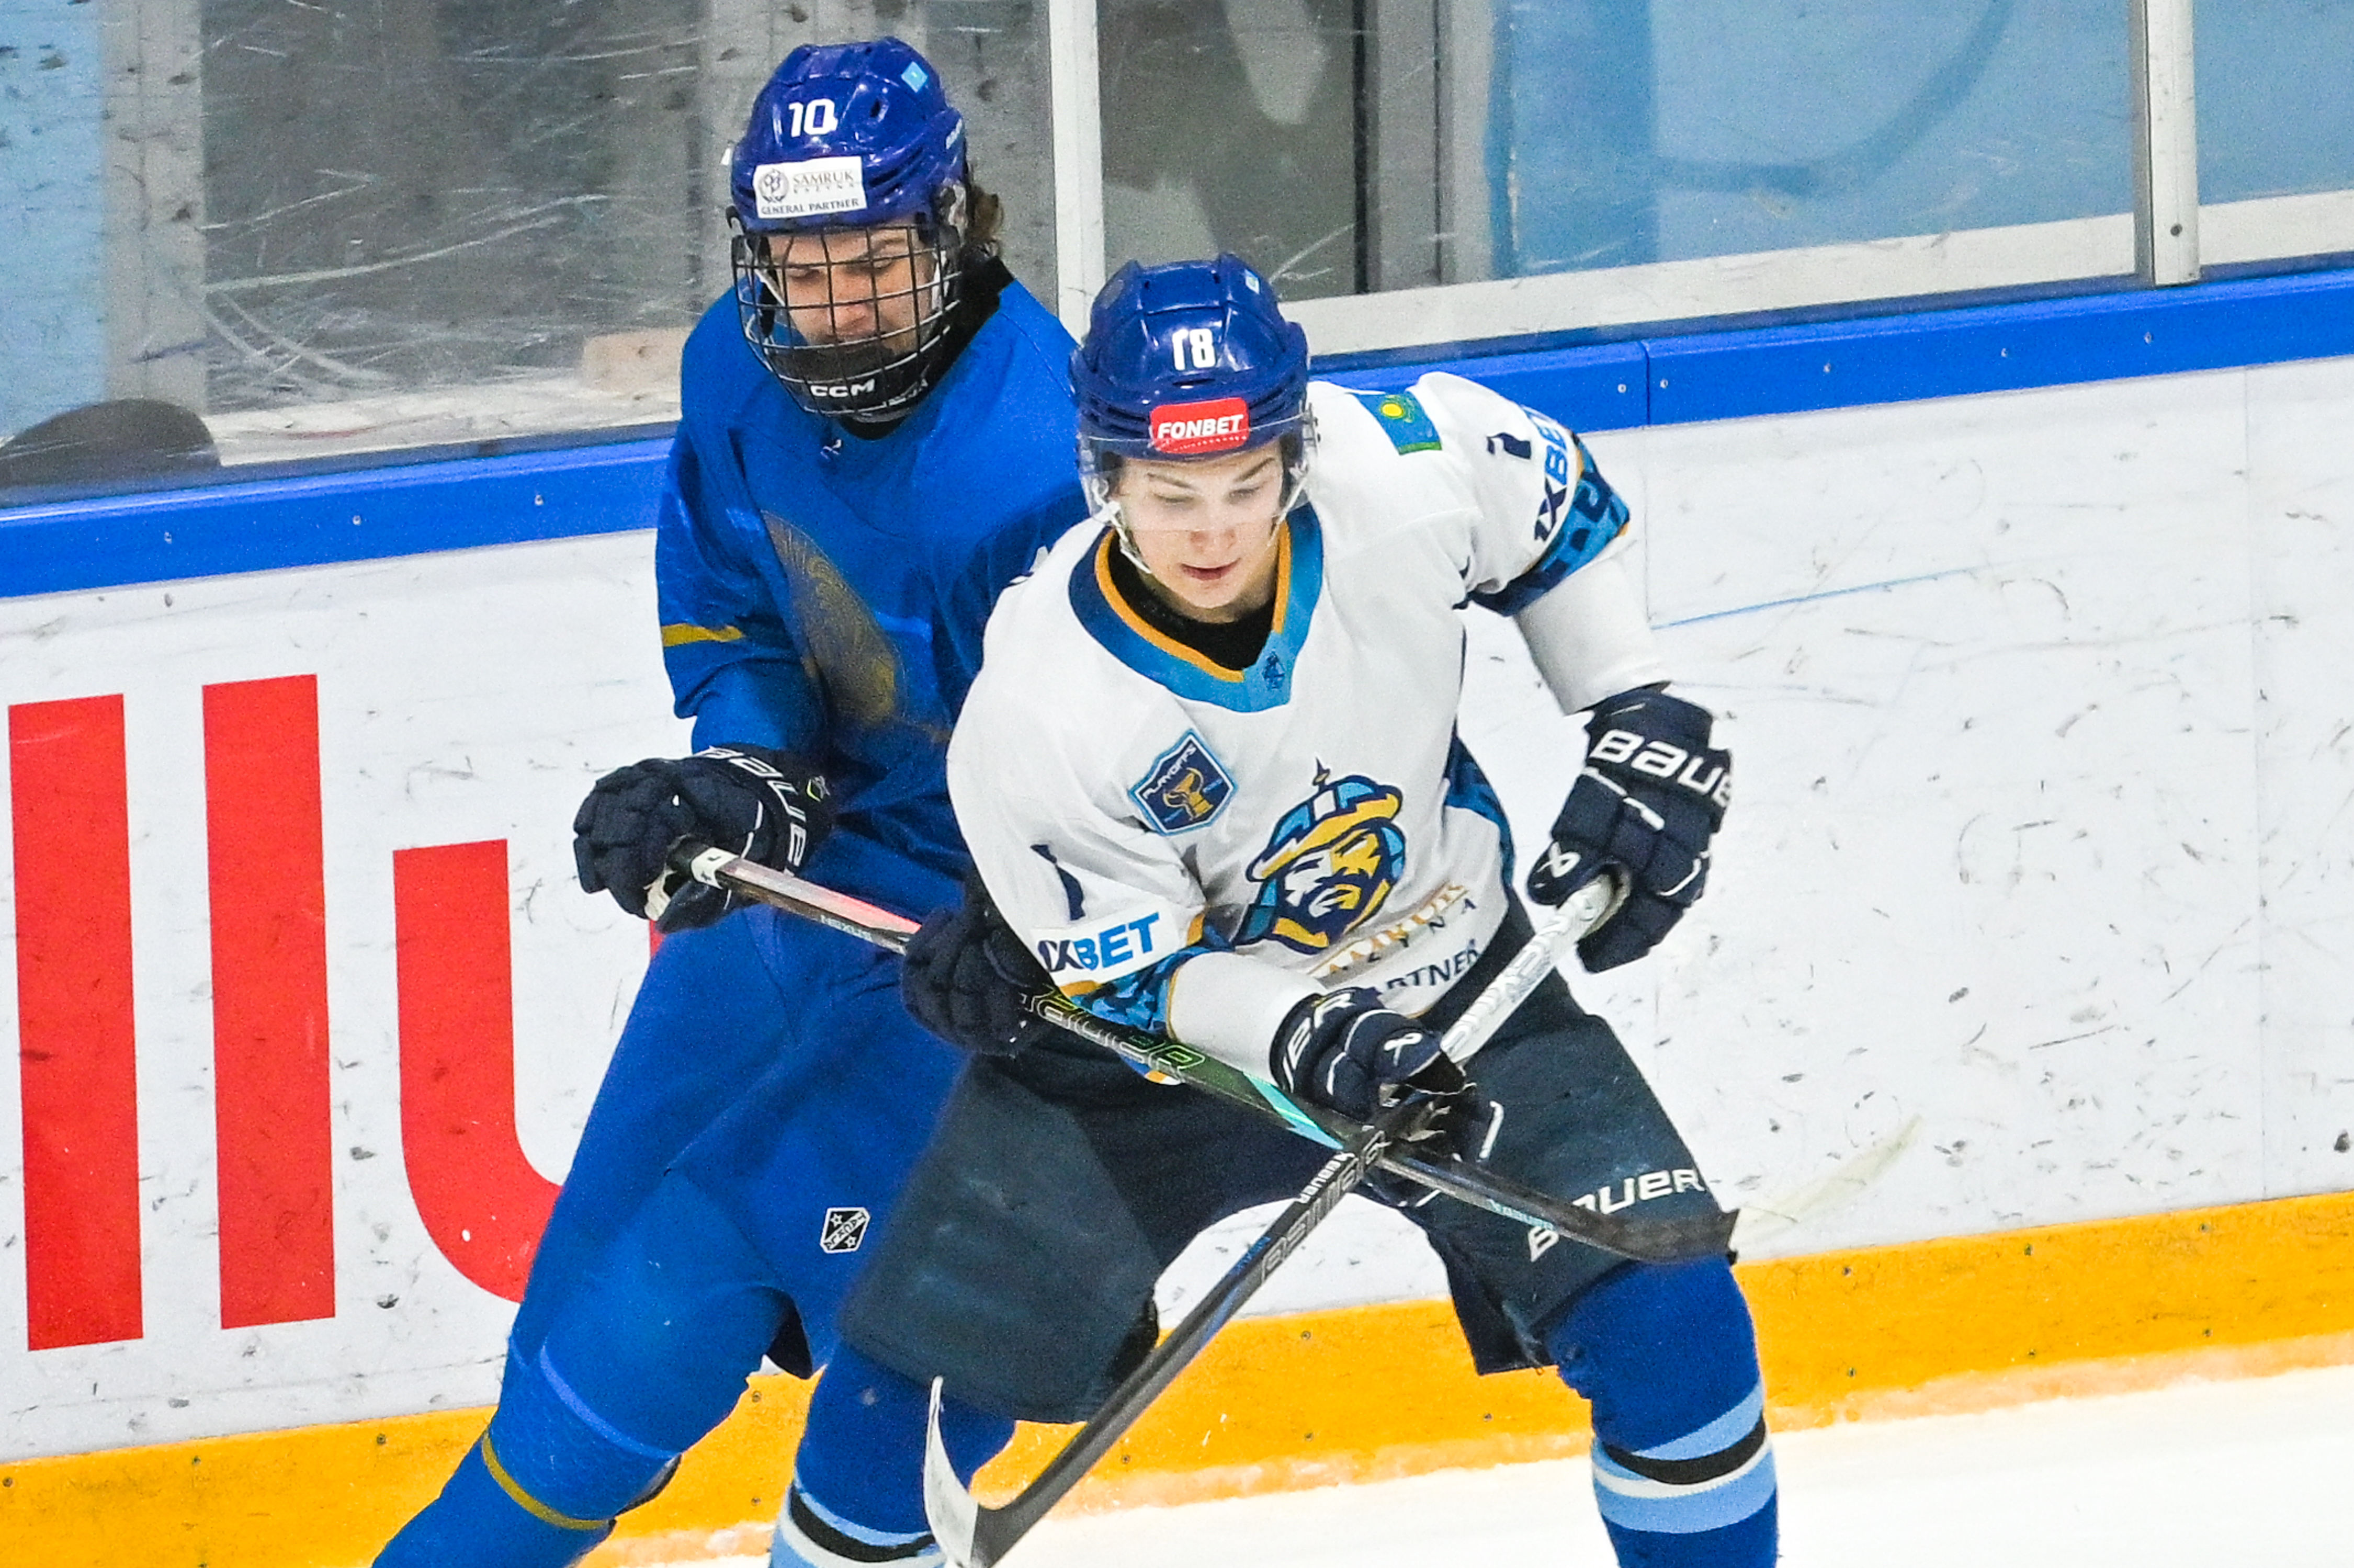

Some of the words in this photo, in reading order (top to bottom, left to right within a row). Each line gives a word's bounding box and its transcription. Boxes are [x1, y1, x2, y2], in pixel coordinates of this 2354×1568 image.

[789, 98, 837, 138] 10
[793, 170, 854, 185] SAMRUK
[761, 204, 805, 215] GENERAL
[809, 198, 859, 210] PARTNER
[1172, 328, 1216, 371] 18
[811, 379, 875, 397] CCM
[1158, 414, 1244, 439] FONBET
[1142, 744, 1196, 799] PLAYOFFS
[1038, 912, 1159, 972] 1XBET
[823, 1212, 867, 1251] TACKLA
